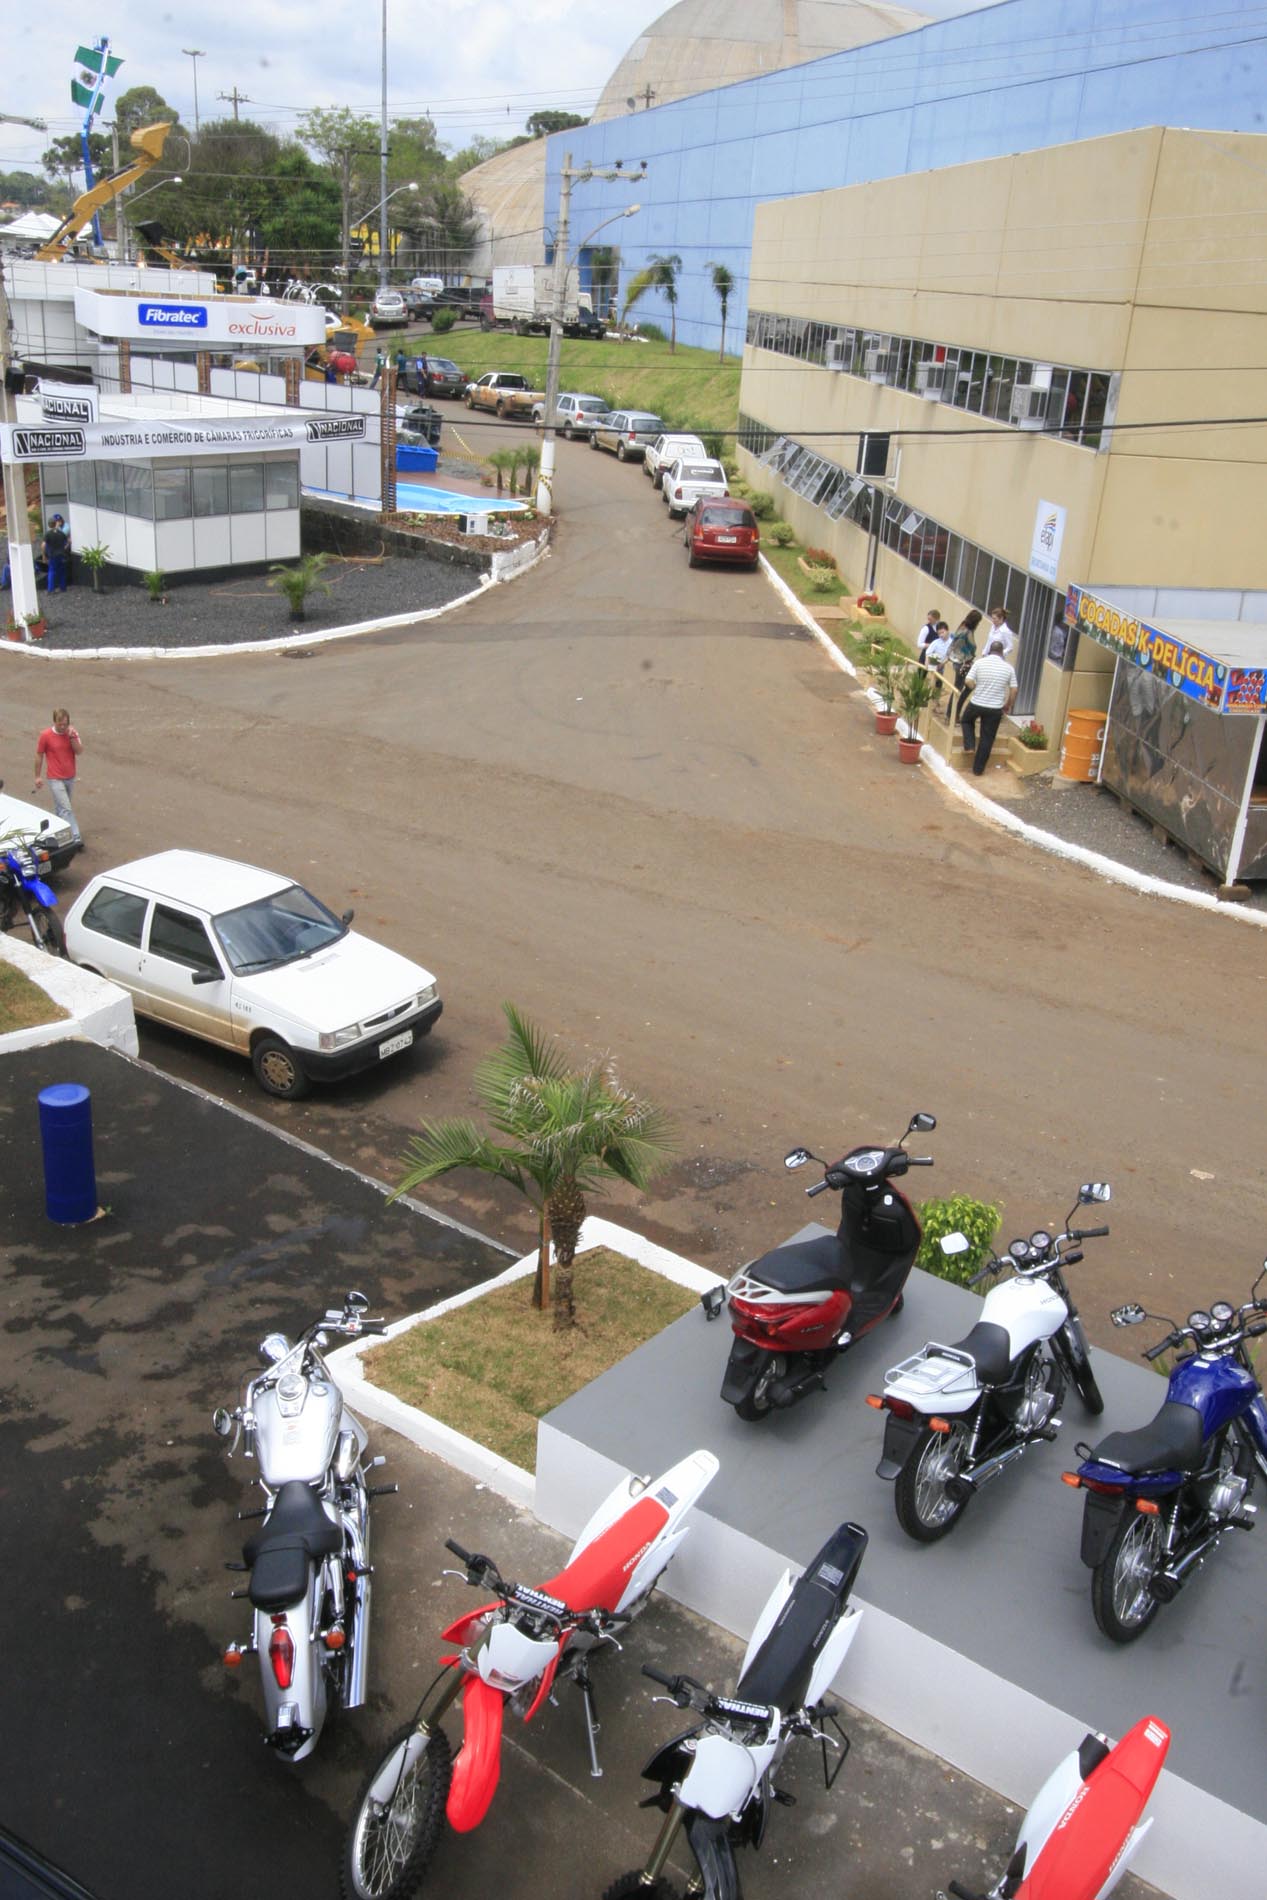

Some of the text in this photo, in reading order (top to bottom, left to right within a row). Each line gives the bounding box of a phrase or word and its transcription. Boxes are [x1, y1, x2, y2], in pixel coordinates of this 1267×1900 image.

[145, 308, 199, 324] Fibratec
[228, 320, 296, 337] exclusiva
[320, 420, 363, 434] NACIONAL
[30, 433, 82, 448] NACIONAL
[144, 433, 150, 444] E
[194, 432, 204, 442] DE
[1080, 596, 1137, 647] COCADAS
[622, 1541, 651, 1572] HONDA
[514, 1590, 564, 1616] RENTHAL
[516, 1583, 566, 1610] RENTHAL
[1057, 1785, 1091, 1831] HONDA
